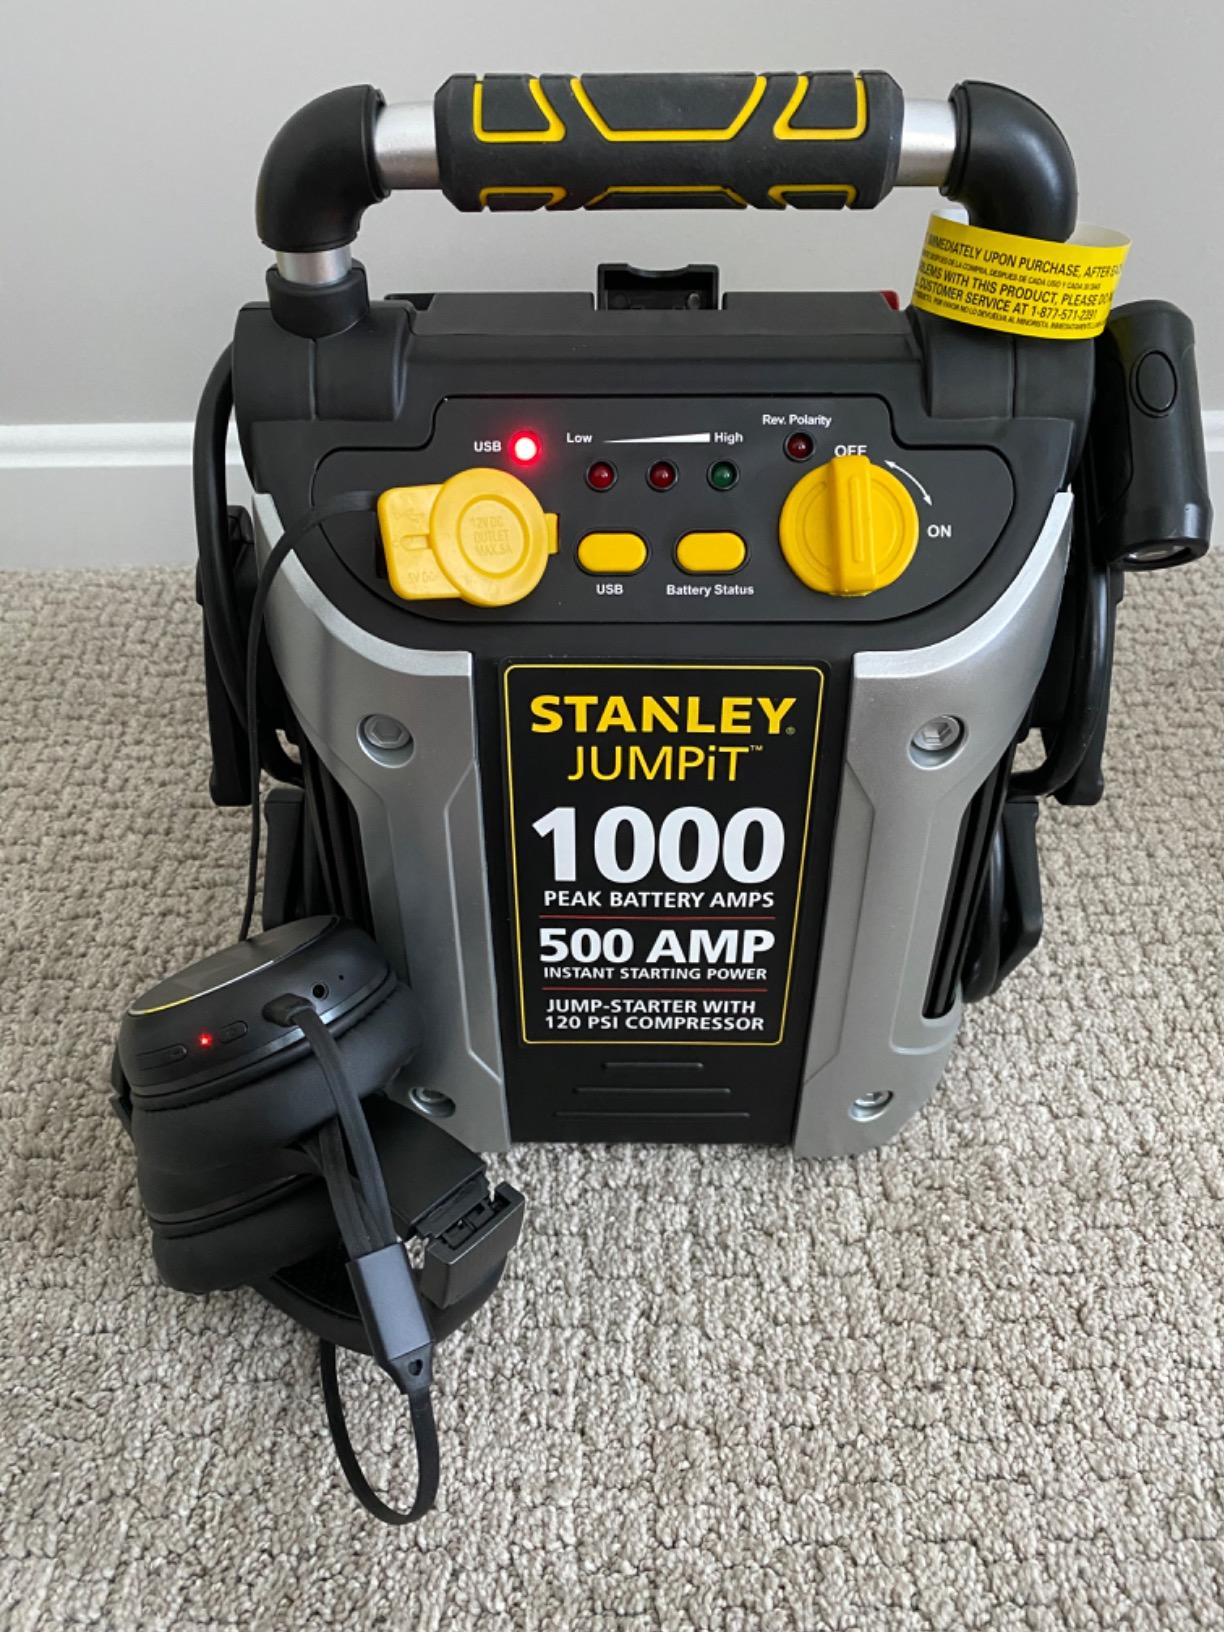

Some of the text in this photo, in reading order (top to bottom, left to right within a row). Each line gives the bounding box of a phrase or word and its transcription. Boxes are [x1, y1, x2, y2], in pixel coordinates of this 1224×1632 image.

[983, 249, 1017, 268] UPON
[1018, 256, 1081, 279] PURCHASE,
[1084, 265, 1112, 278] AFTER
[919, 276, 964, 301] CUSTOMER
[965, 292, 1012, 313] SERVICE
[1012, 302, 1029, 315] AT
[944, 269, 970, 287] WITH
[972, 276, 998, 294] THIS
[999, 282, 1058, 305] PRODUCT,
[1061, 292, 1099, 307] PLEASE
[762, 413, 832, 428] Rev. Polarity
[566, 432, 593, 444] Low
[714, 431, 743, 445] High
[473, 440, 502, 453] USB
[834, 445, 867, 457] OFF
[926, 524, 952, 538] ON
[595, 583, 624, 596] USB
[666, 583, 755, 598] Battery Status
[532, 805, 785, 884] 1000
[544, 890, 775, 909] PEAK BATTERY AMPS
[539, 927, 776, 964] 500 AMP
[543, 966, 768, 981] INSTANT STARTING POWER
[546, 998, 756, 1015] JUMP-STARTER WITH
[545, 1015, 765, 1032] 120 PSI COMPRESSOR
